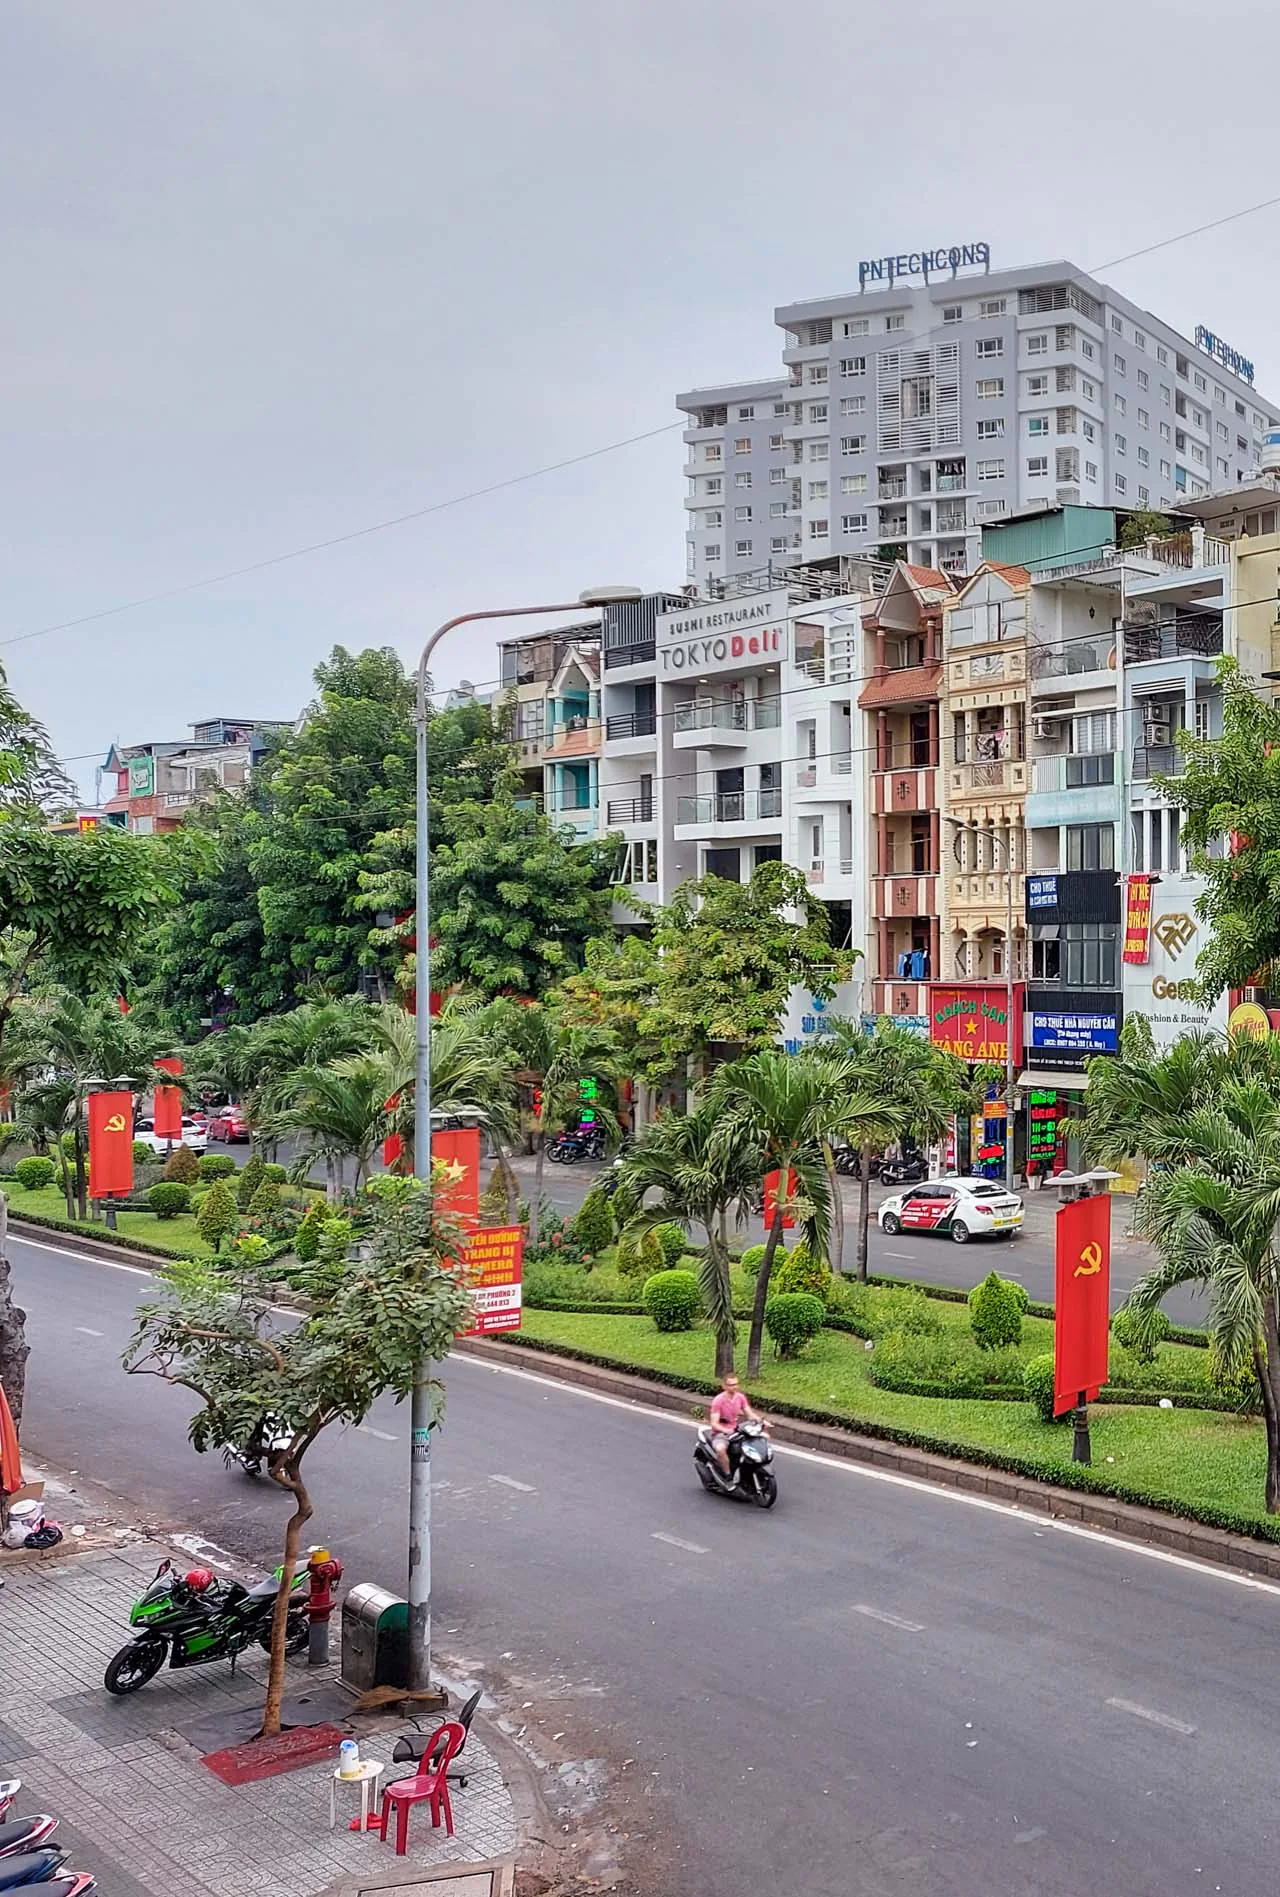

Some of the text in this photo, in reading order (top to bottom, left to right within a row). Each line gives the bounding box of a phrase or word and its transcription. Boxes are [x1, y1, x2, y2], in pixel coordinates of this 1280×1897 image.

[859, 242, 987, 281] PNTECHCONS
[670, 604, 771, 635] SUSHI RESTAURANT
[1181, 1013, 1210, 1026] Beauty
[472, 1259, 513, 1272] AMERA
